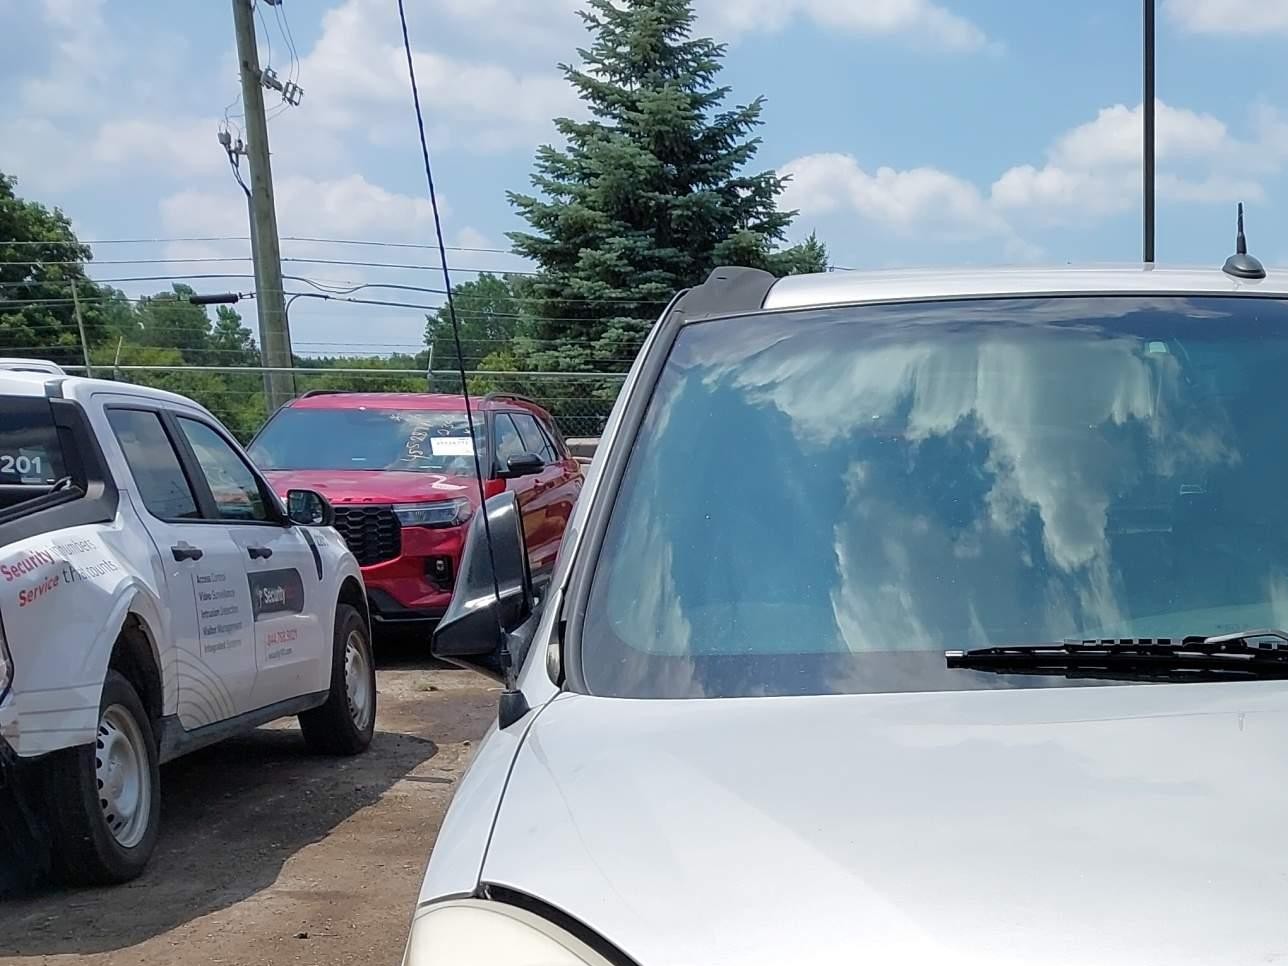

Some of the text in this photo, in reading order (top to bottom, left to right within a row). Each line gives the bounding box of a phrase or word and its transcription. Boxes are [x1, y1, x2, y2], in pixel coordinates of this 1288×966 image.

[0, 455, 41, 474] 201
[0, 547, 55, 582] Security
[18, 574, 60, 608] Service
